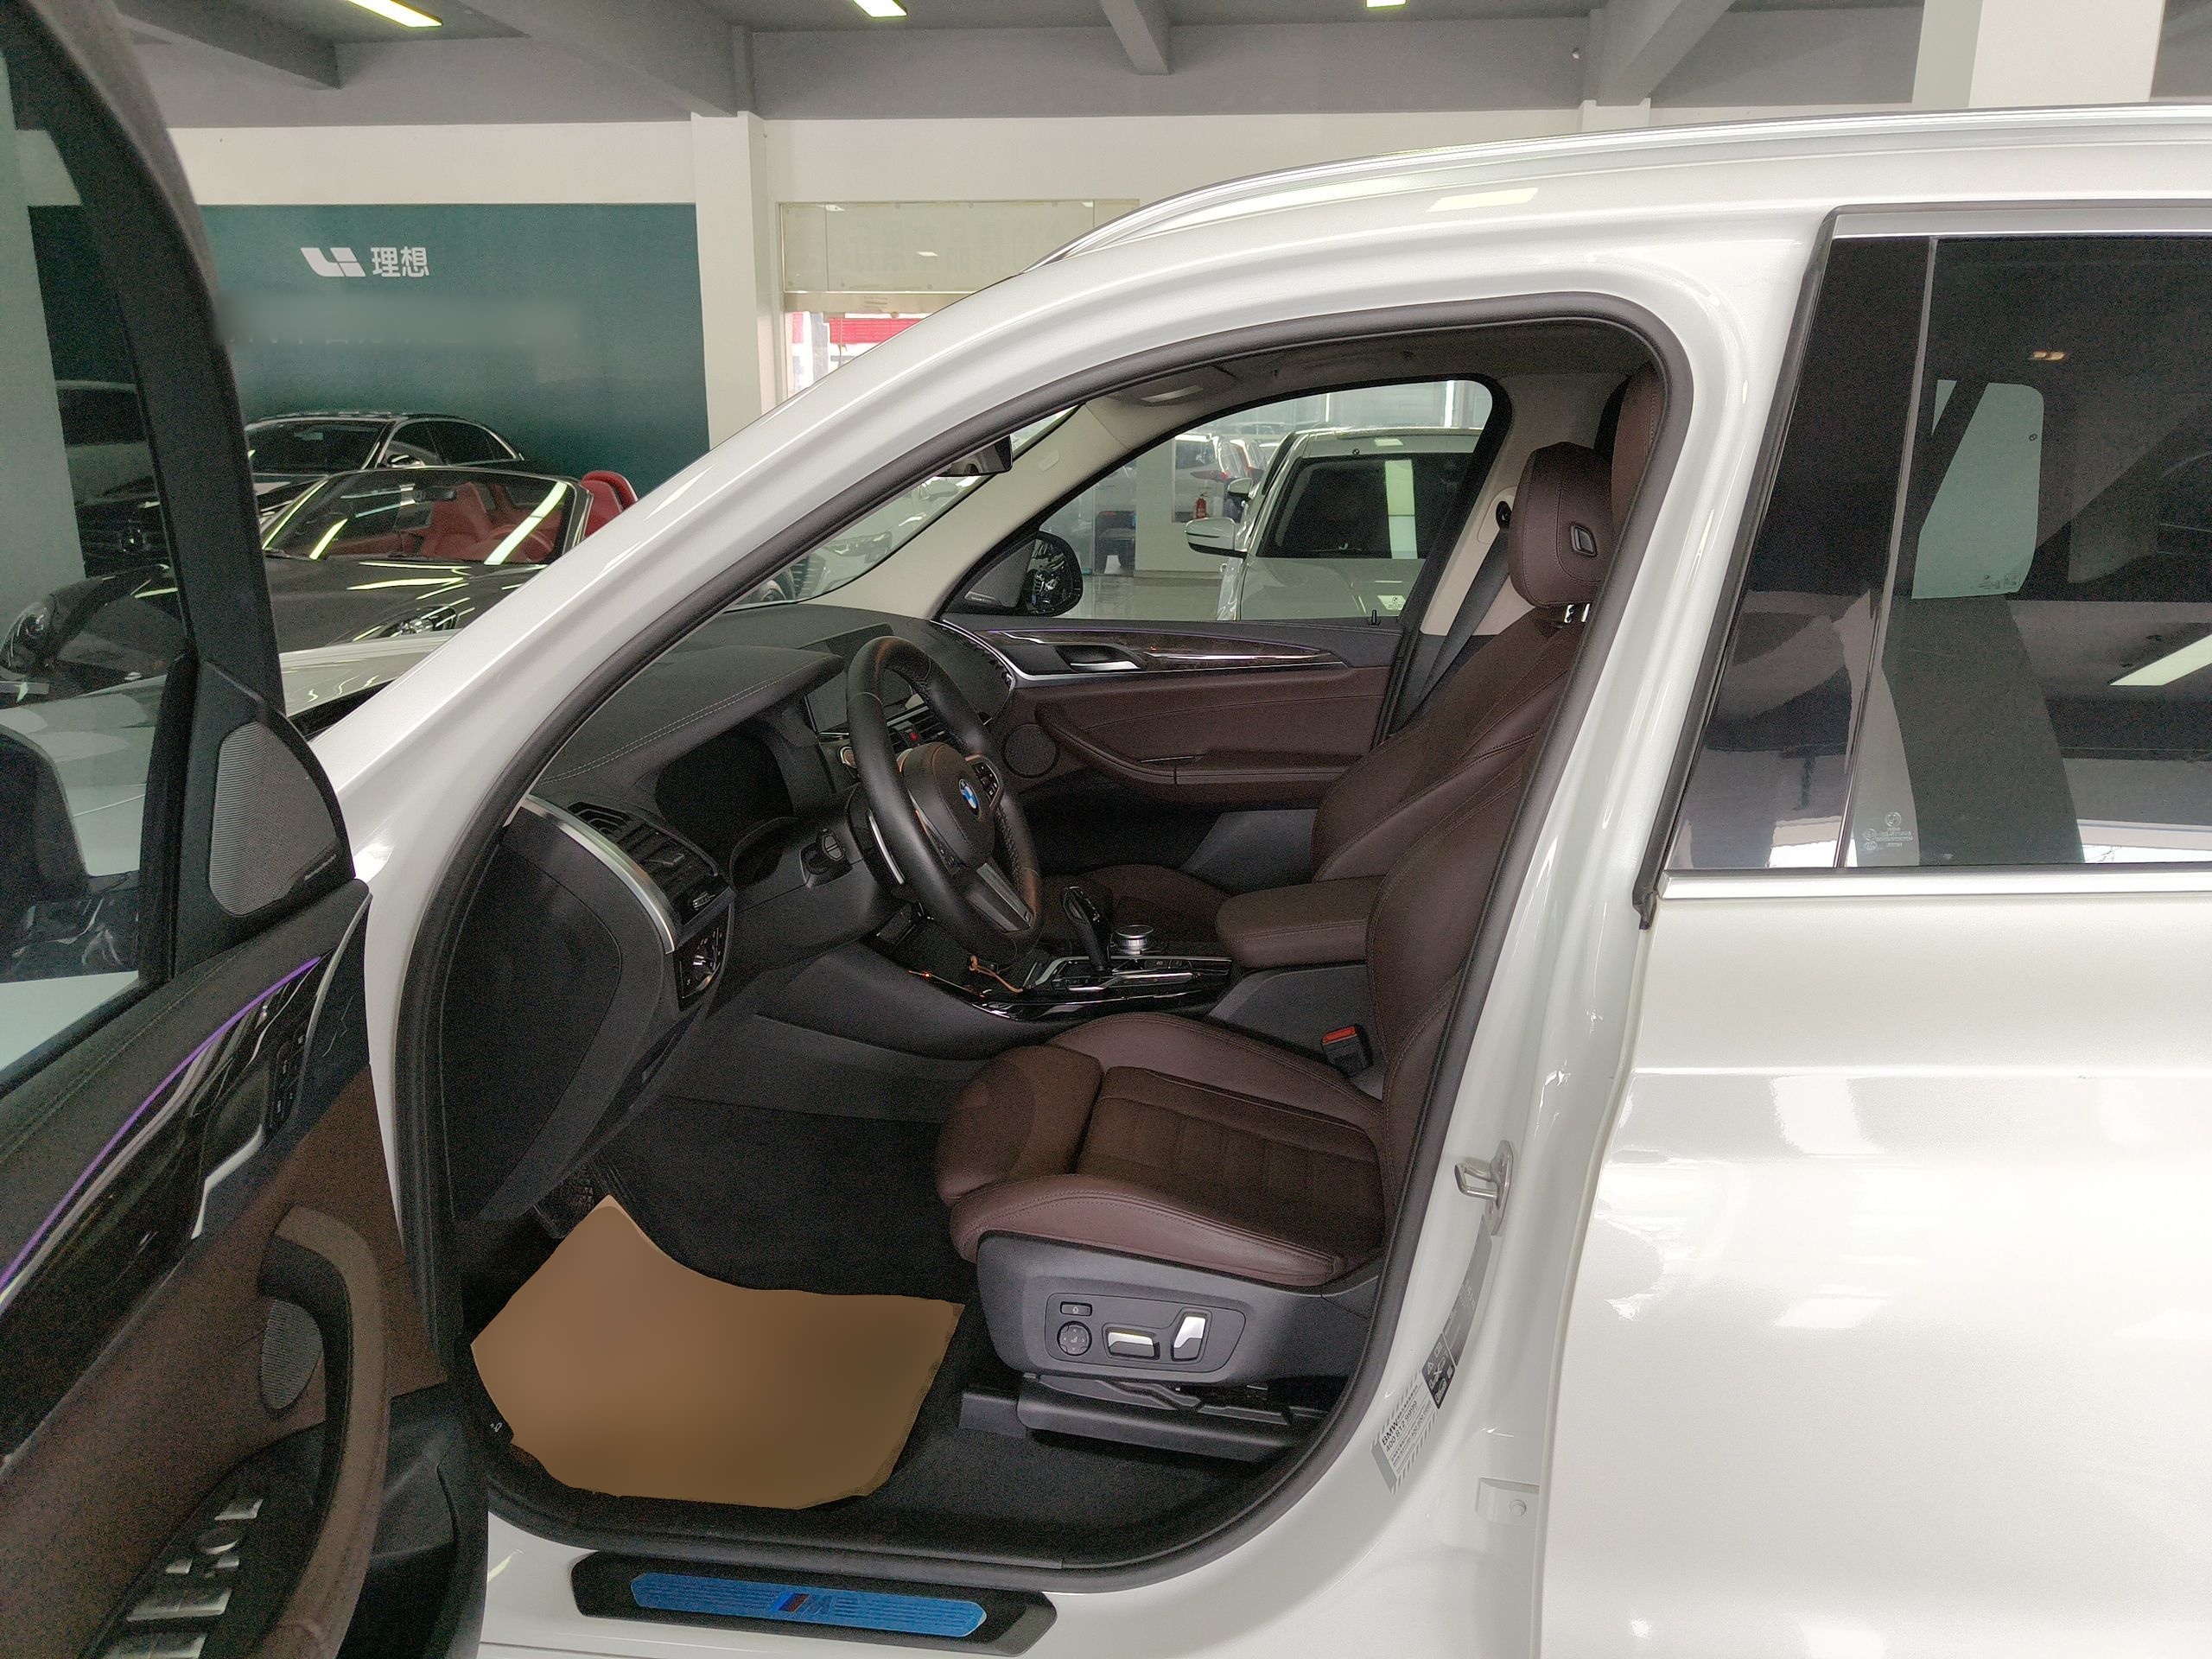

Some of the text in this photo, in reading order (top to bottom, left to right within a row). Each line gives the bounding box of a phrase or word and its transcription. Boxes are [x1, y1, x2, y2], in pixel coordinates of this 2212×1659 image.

[370, 246, 429, 277] 理想
[1382, 1419, 1398, 1446] BMW
[1387, 1436, 1396, 1452] 400
